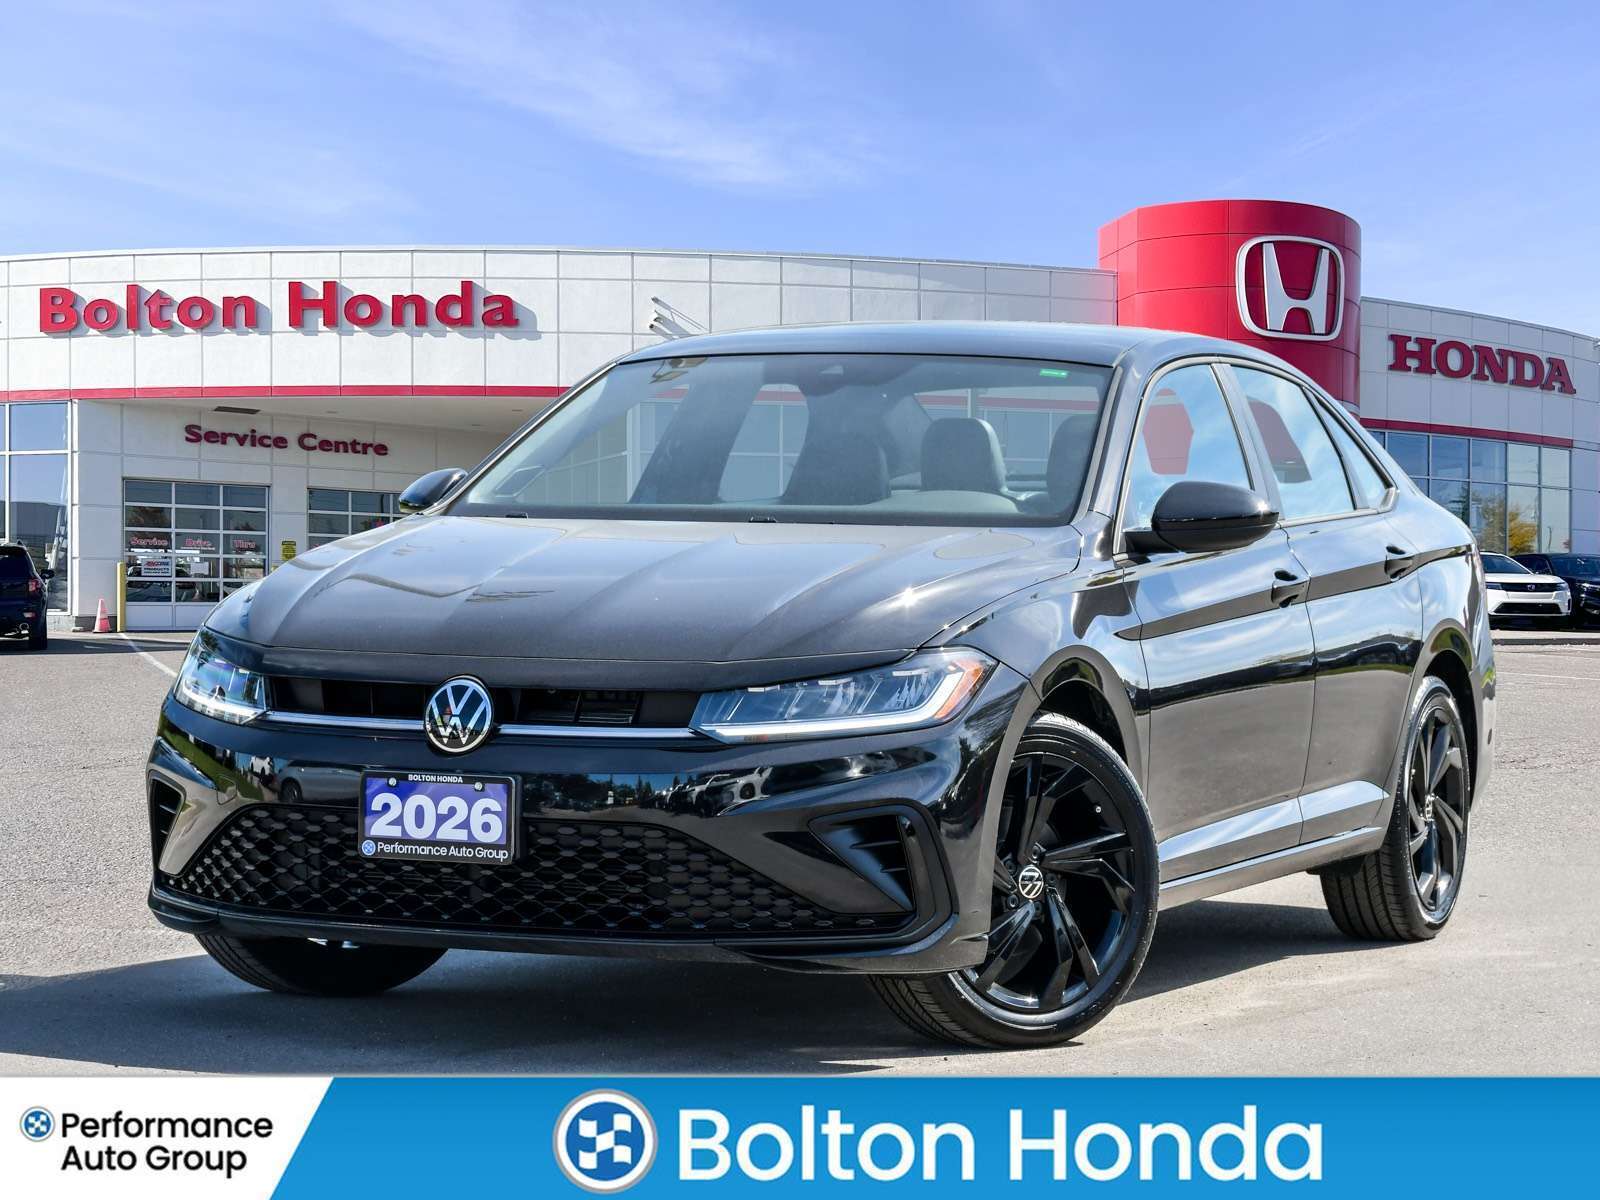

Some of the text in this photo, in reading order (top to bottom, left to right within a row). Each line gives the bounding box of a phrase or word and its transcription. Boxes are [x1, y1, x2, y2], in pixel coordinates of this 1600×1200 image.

[39, 280, 520, 334] Bolton Honda
[1388, 333, 1577, 394] HONDA
[184, 424, 389, 457] Service Centre
[408, 773, 464, 784] BOLTON HONDA
[370, 792, 503, 843] 2026
[377, 843, 509, 862] Performance Auto Group
